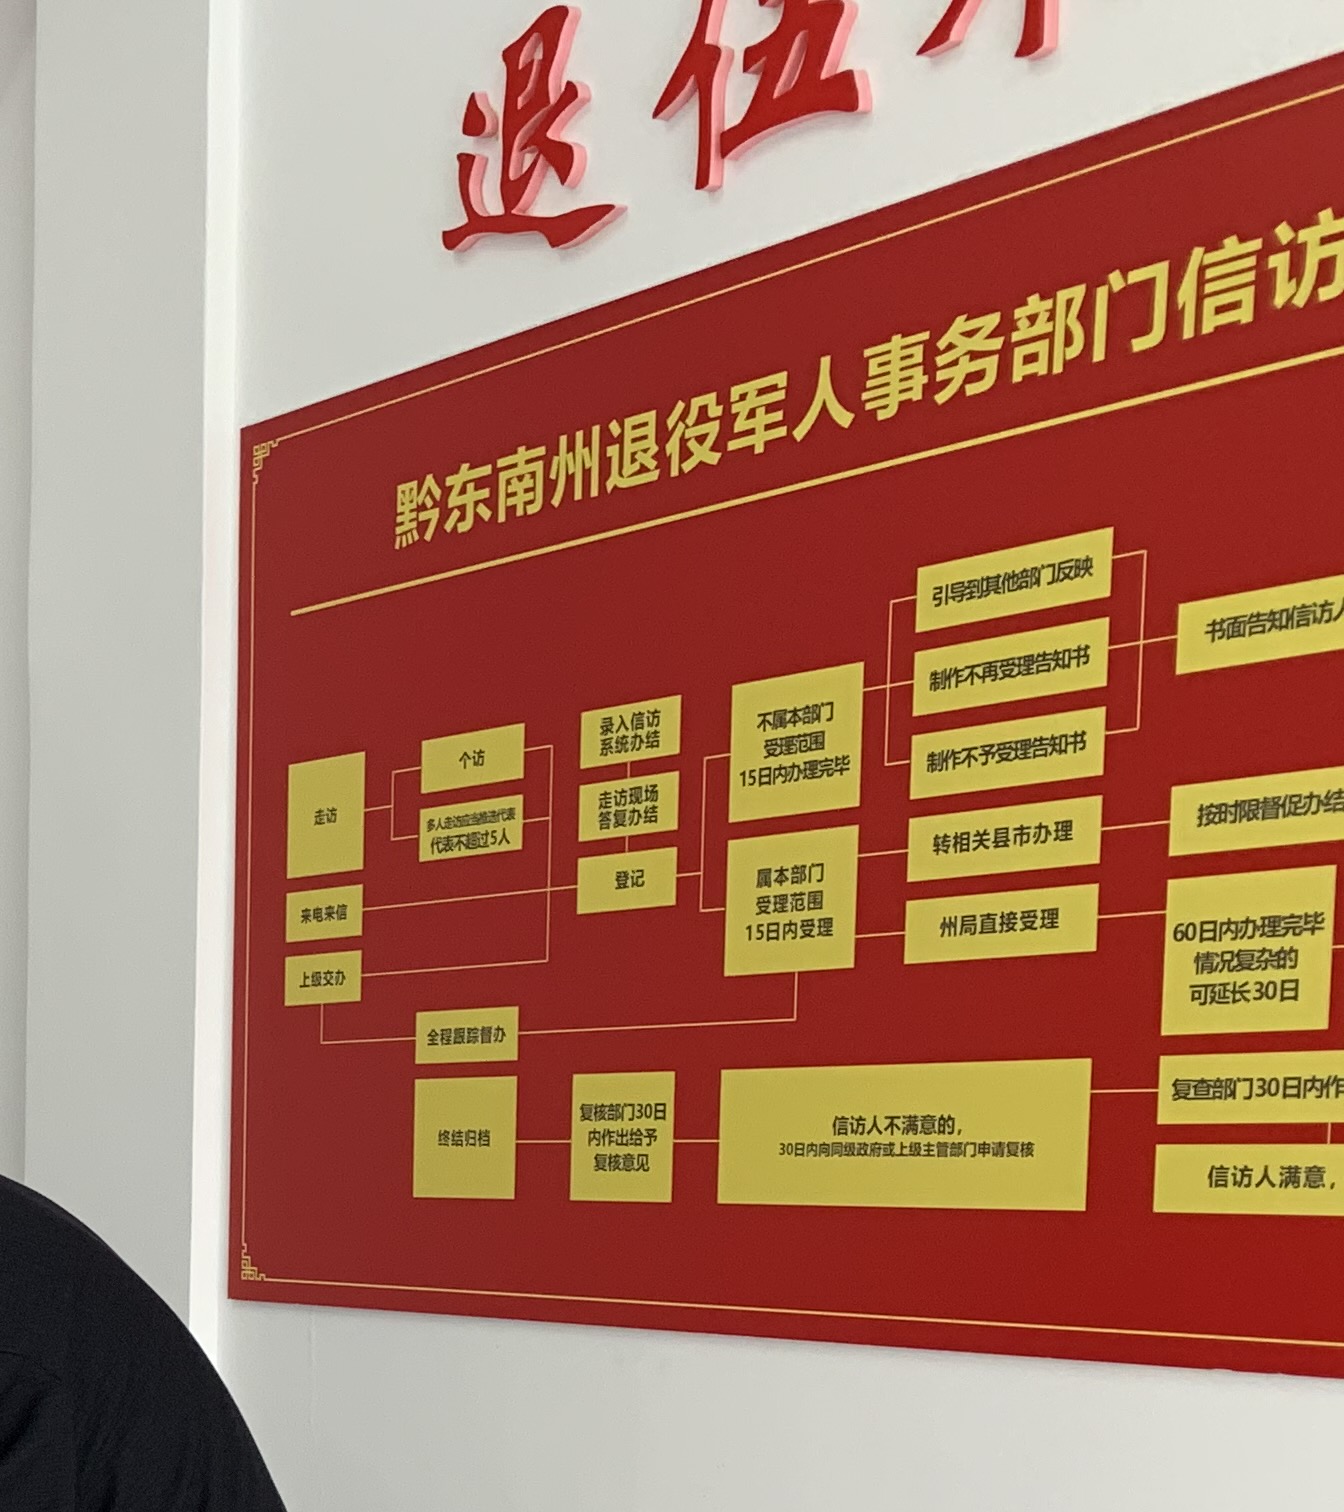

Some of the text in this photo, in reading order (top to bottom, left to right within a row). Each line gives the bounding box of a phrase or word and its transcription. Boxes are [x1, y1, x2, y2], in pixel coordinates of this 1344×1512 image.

[442, 0, 1060, 250] 退伍
[394, 207, 1344, 551] 黔东南州退役军人事务部门信访
[932, 555, 1094, 607] 引导到其他部门反映
[929, 644, 1090, 692] 制作不再受理告知书
[600, 708, 661, 737] 录入信访
[757, 701, 834, 732] 不属本部门
[599, 730, 660, 757] 系统办结
[763, 730, 825, 759] 受理范围
[926, 730, 1087, 773] 制作不予受理告知书
[458, 748, 485, 770] 个访
[739, 755, 850, 787] 15日内办理完毕
[598, 784, 658, 810] 走访现场
[1197, 788, 1344, 827] 按时限督促办结
[313, 807, 338, 827] 走访
[598, 805, 658, 831] 答复办结
[431, 827, 510, 855] 代表不超过5人
[932, 820, 1074, 856] 转相关县市办理
[615, 869, 645, 890] 登记
[756, 863, 824, 889] 属本部门
[301, 903, 348, 924] 来电来信
[755, 890, 823, 916] 受理范围
[745, 917, 833, 942] 15日内受理
[939, 907, 1060, 939] 州局直接受理
[1173, 911, 1325, 943] 60日内办理完毕
[1194, 946, 1299, 975] 情况复杂的
[299, 969, 346, 989] 上级交办
[1189, 978, 1299, 1006] 可延长30日
[427, 1025, 506, 1046] 全程跟踪督办
[579, 1103, 667, 1121] 复核部门30日
[437, 1129, 491, 1148] 终结归档
[588, 1128, 657, 1147] 内作出给予
[594, 1153, 650, 1172] 复核意见
